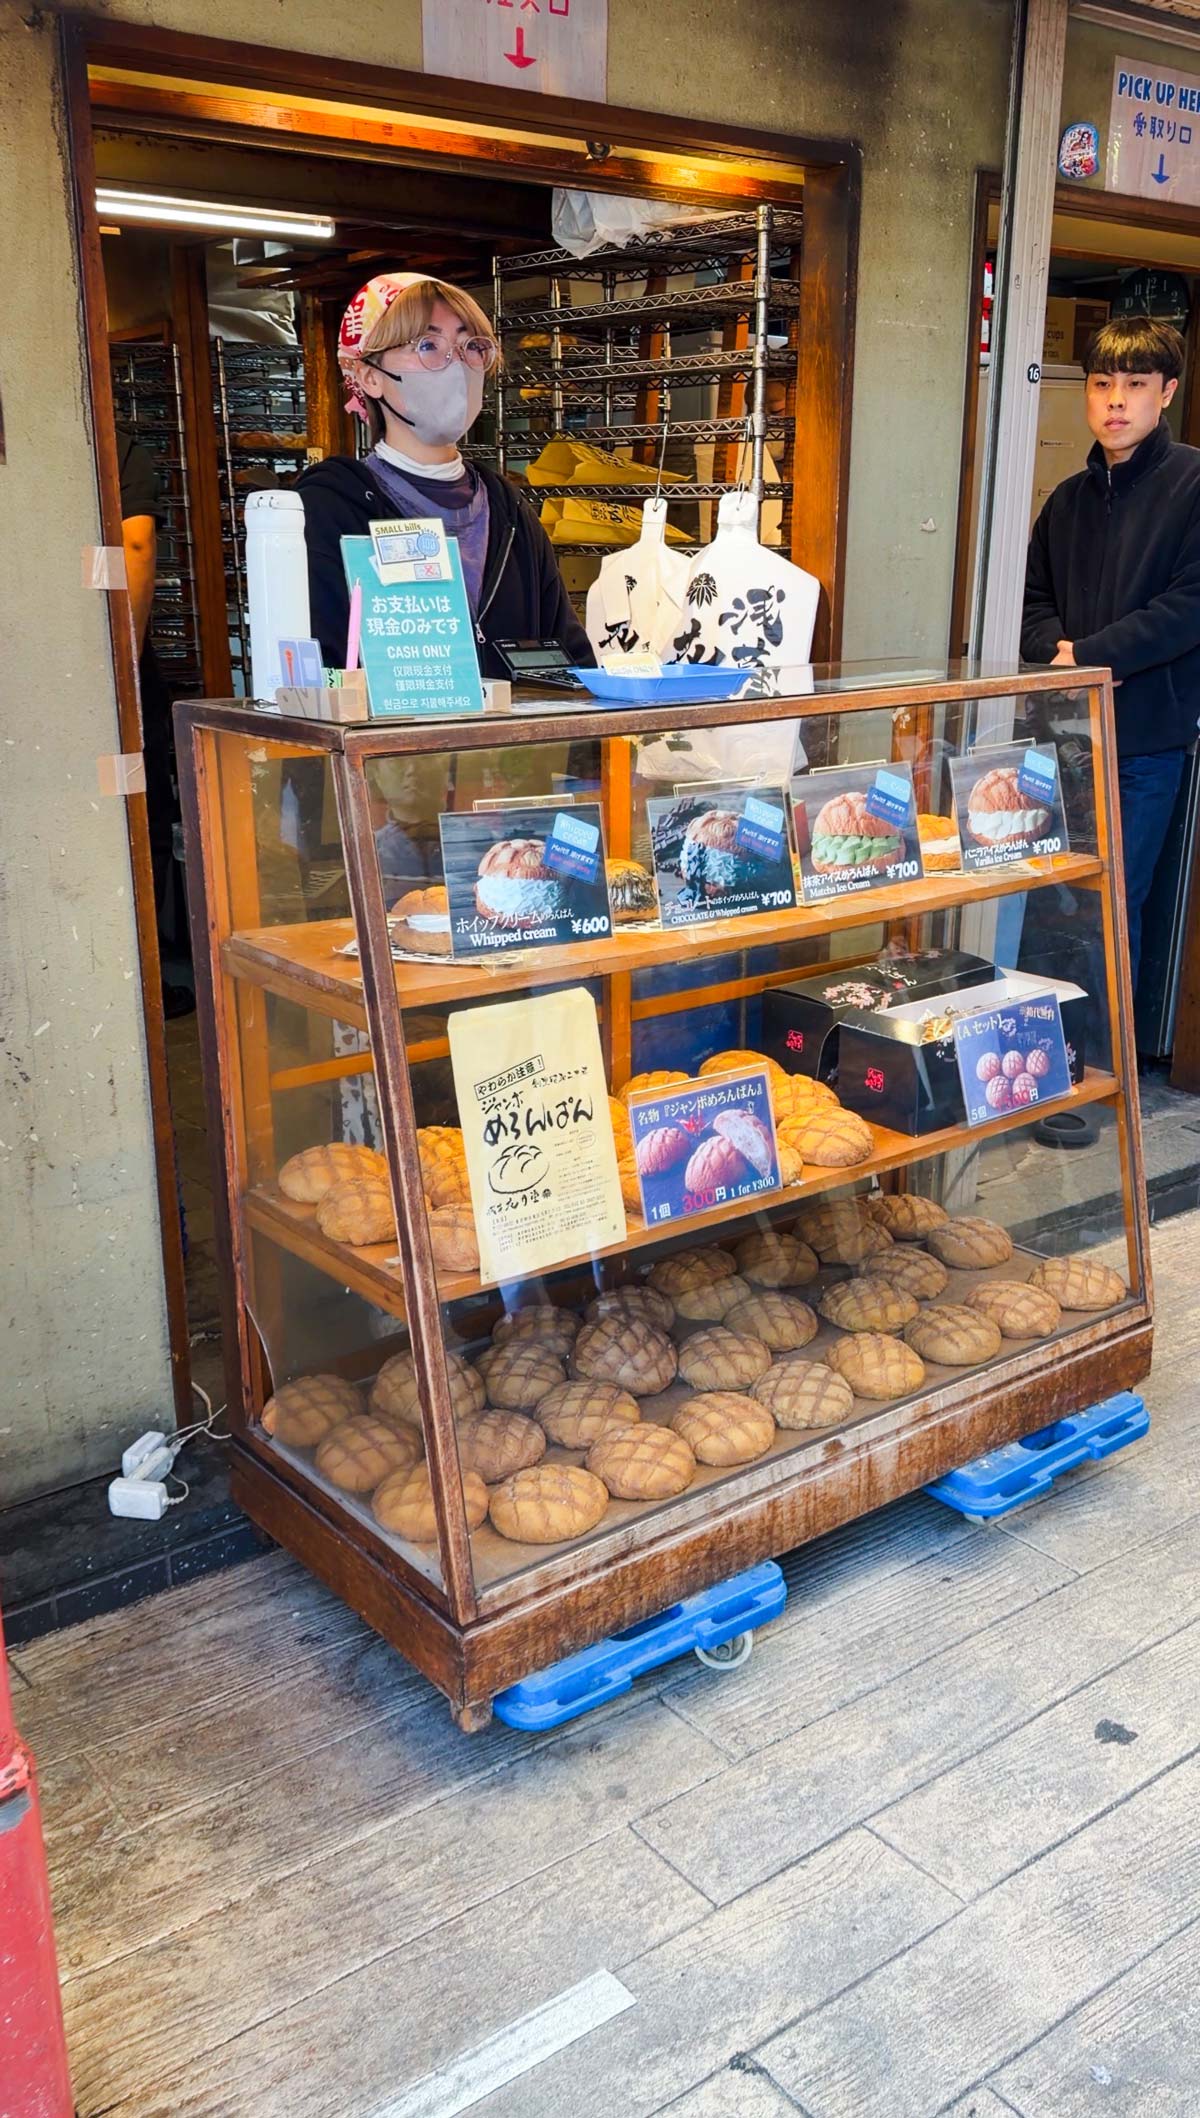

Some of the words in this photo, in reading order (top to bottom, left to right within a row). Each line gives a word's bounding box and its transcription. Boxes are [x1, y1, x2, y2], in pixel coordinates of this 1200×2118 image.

[1118, 72, 1152, 101] PICK
[1155, 81, 1175, 106] UP
[1133, 111, 1192, 144] 受取り口
[1029, 367, 1039, 380] 16
[374, 524, 403, 535] SMALL
[404, 523, 421, 532] bills
[371, 595, 452, 615] お支払いは
[366, 618, 461, 636] 現金のみです
[387, 646, 420, 659] CASH
[423, 645, 451, 658] ONLY
[1031, 837, 1061, 855] ¥700
[886, 860, 919, 879] ¥700
[760, 889, 792, 907] ¥700
[809, 883, 836, 898] Matcha
[836, 882, 848, 893] Ice
[847, 879, 871, 891] Cream
[570, 915, 609, 935] ¥600
[671, 910, 709, 925] CHOCOLATE
[469, 928, 522, 948] Whipped
[523, 927, 557, 943] cream
[637, 1107, 660, 1126] 名物
[650, 1203, 672, 1220] 1個
[682, 1186, 727, 1213] 300円
[738, 1183, 751, 1196] for
[752, 1176, 775, 1192] ¥300
